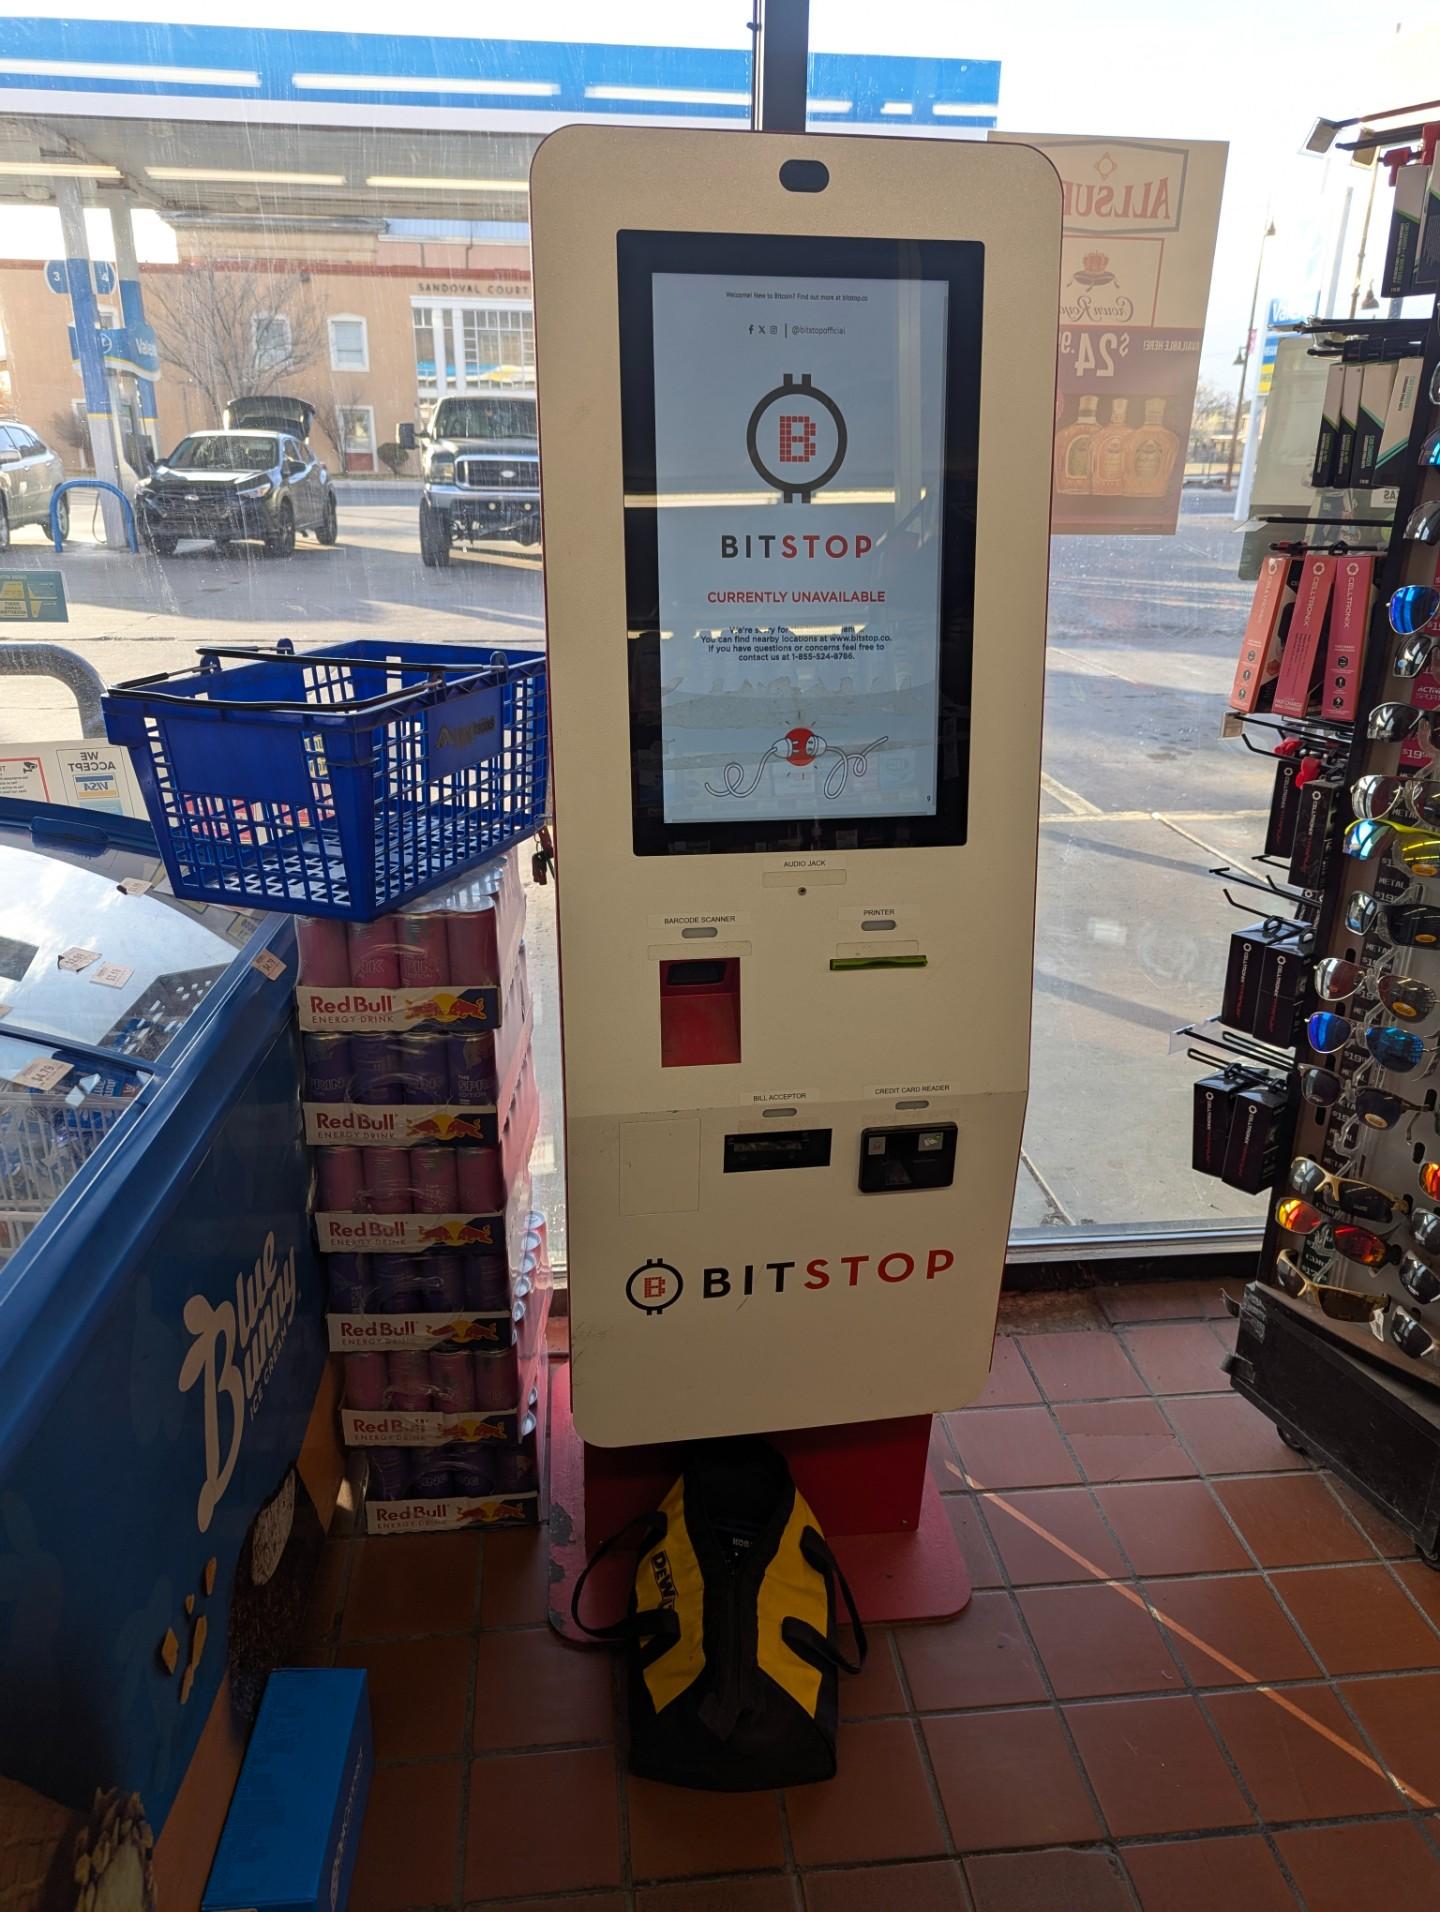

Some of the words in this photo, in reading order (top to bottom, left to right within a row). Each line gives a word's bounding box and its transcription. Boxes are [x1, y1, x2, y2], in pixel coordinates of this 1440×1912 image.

[53, 272, 60, 281] 3
[101, 273, 109, 282] 4
[418, 283, 480, 294] SANDOVAL
[487, 284, 529, 295] COURT
[791, 325, 846, 337] @bitstopofficial
[721, 535, 872, 559] BITSTOP
[707, 591, 788, 603] CURRENTLY
[791, 591, 886, 603] UNAVAILABLE
[1303, 576, 1320, 627] CELLTRONIX
[1343, 576, 1356, 629] CELLTRONIX
[701, 635, 716, 643] You
[734, 634, 750, 643] find
[752, 635, 780, 645] nearby
[781, 634, 818, 643] locations
[708, 643, 715, 652] If
[716, 644, 731, 654] you
[732, 642, 752, 652] have
[754, 643, 792, 653] questions
[804, 643, 841, 651] concerns
[842, 642, 857, 651] feel
[858, 642, 874, 651] free
[876, 642, 885, 651] to
[738, 653, 769, 662] contact
[770, 653, 780, 661] us
[781, 653, 791, 661] at
[863, 909, 895, 917] PRINTER
[664, 917, 699, 925] BARCODE
[701, 915, 736, 924] SCANNER
[310, 996, 354, 1013] Red
[354, 996, 393, 1013] Bull
[312, 1015, 355, 1024] ENERGY
[360, 1015, 394, 1024] DRINK
[875, 1087, 900, 1095] CREDIT
[901, 1086, 921, 1094] CARD
[922, 1085, 950, 1093] READER
[753, 1094, 768, 1102] BILL
[769, 1092, 807, 1101] ACCEPTOR
[316, 1112, 358, 1130] Red
[357, 1113, 395, 1130] Bull
[318, 1131, 359, 1139] ENERGY
[329, 1221, 367, 1237] Red
[369, 1221, 406, 1237] Bull
[703, 1249, 955, 1299] BITSTOP
[340, 1321, 377, 1337] Red
[380, 1321, 415, 1336] Bull
[249, 1386, 264, 1422] ICE
[354, 1419, 388, 1433] Red
[376, 1505, 411, 1521] Red
[413, 1504, 447, 1519] Bull
[377, 1521, 416, 1529] ENERGY
